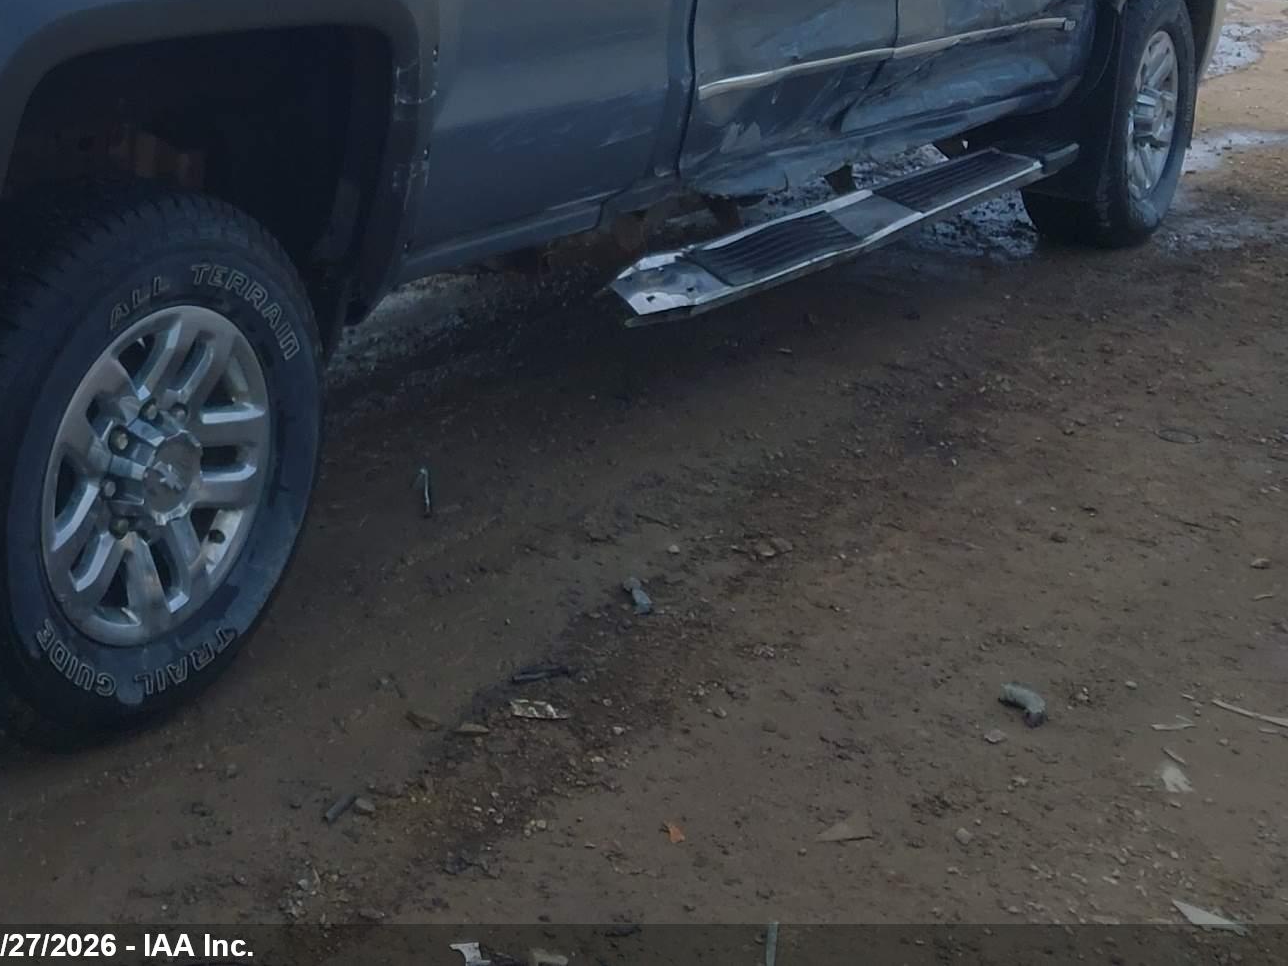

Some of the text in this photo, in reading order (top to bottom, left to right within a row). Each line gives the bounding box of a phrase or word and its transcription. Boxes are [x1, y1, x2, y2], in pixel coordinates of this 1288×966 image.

[110, 262, 301, 361] ALL TERRAIN
[36, 618, 237, 697] TRAIL GUIDE
